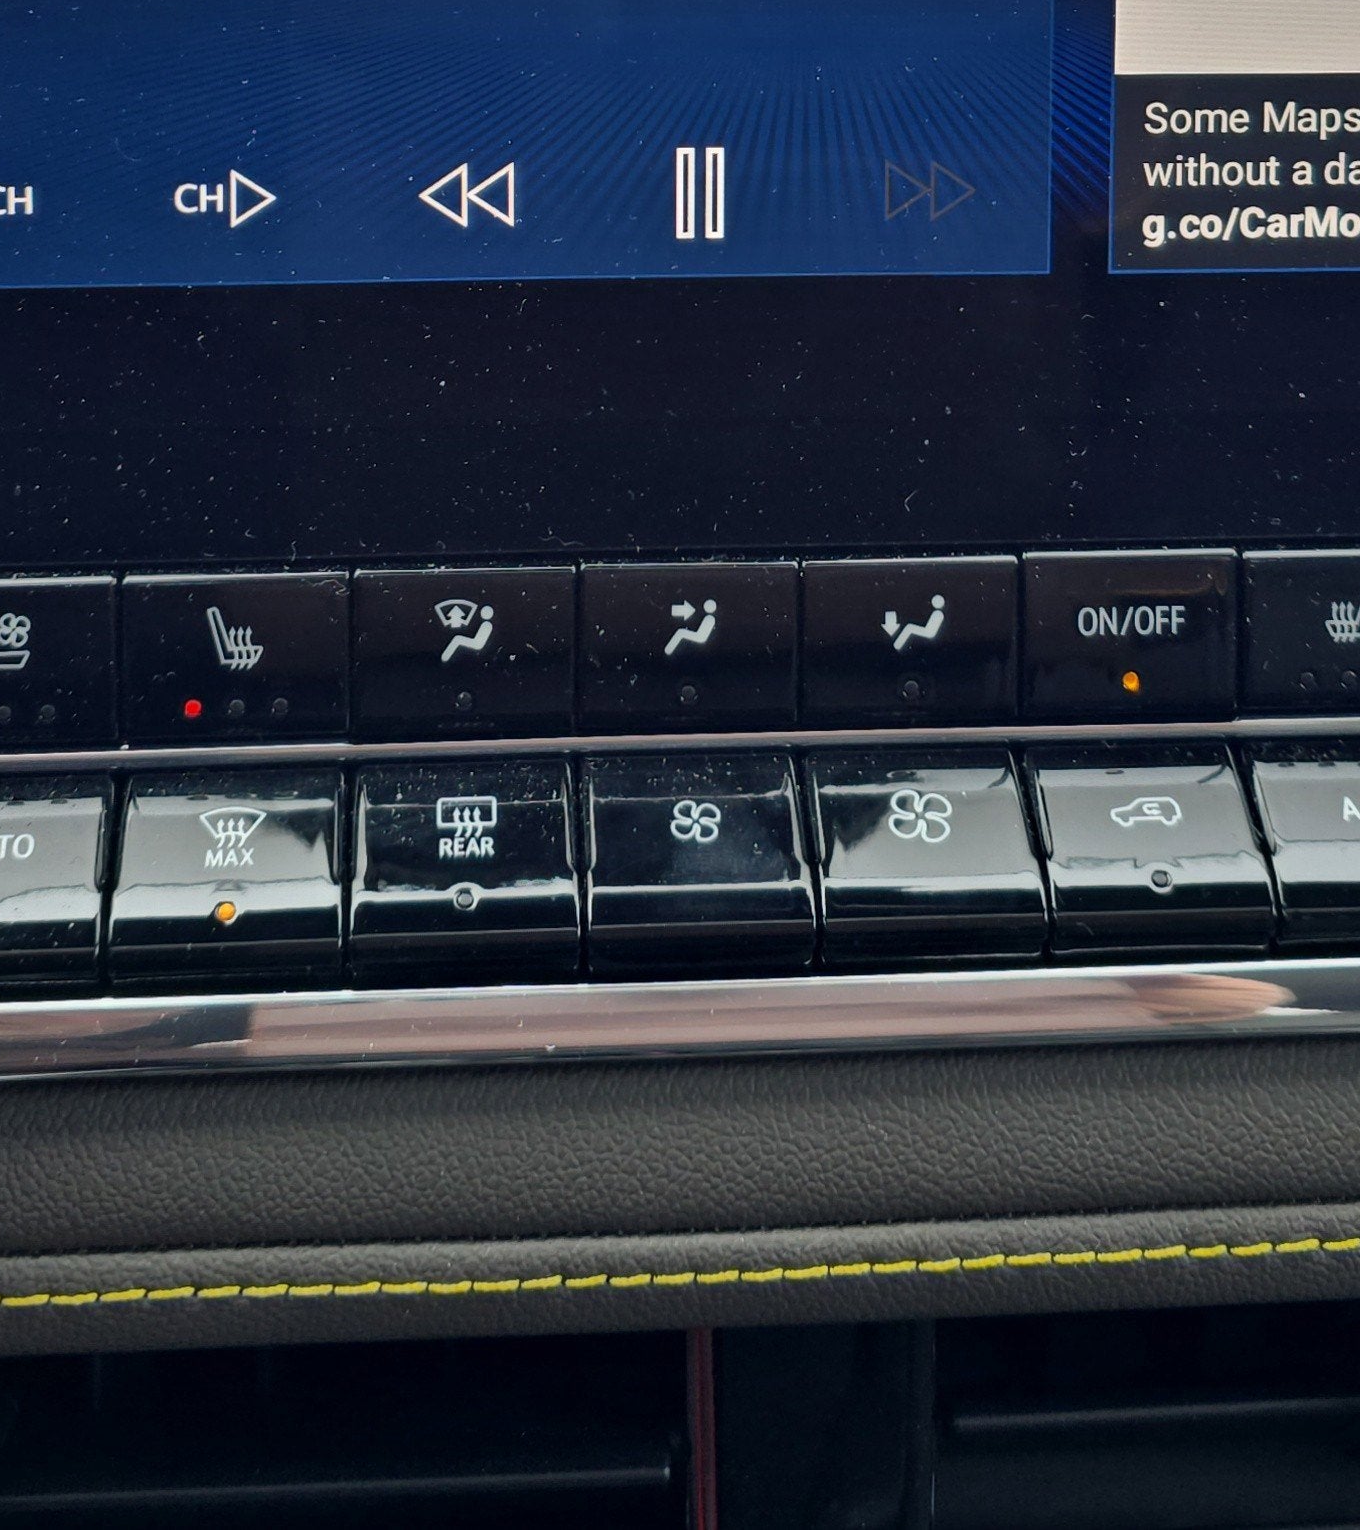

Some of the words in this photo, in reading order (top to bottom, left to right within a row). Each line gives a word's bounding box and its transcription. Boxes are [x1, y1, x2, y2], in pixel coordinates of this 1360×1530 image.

[1143, 101, 1250, 133] Some
[1143, 154, 1280, 187] without
[1291, 162, 1314, 186] a
[173, 183, 225, 215] CH
[1077, 606, 1186, 637] ON/OFF
[204, 847, 255, 868] MAX
[439, 836, 495, 858] REAR
